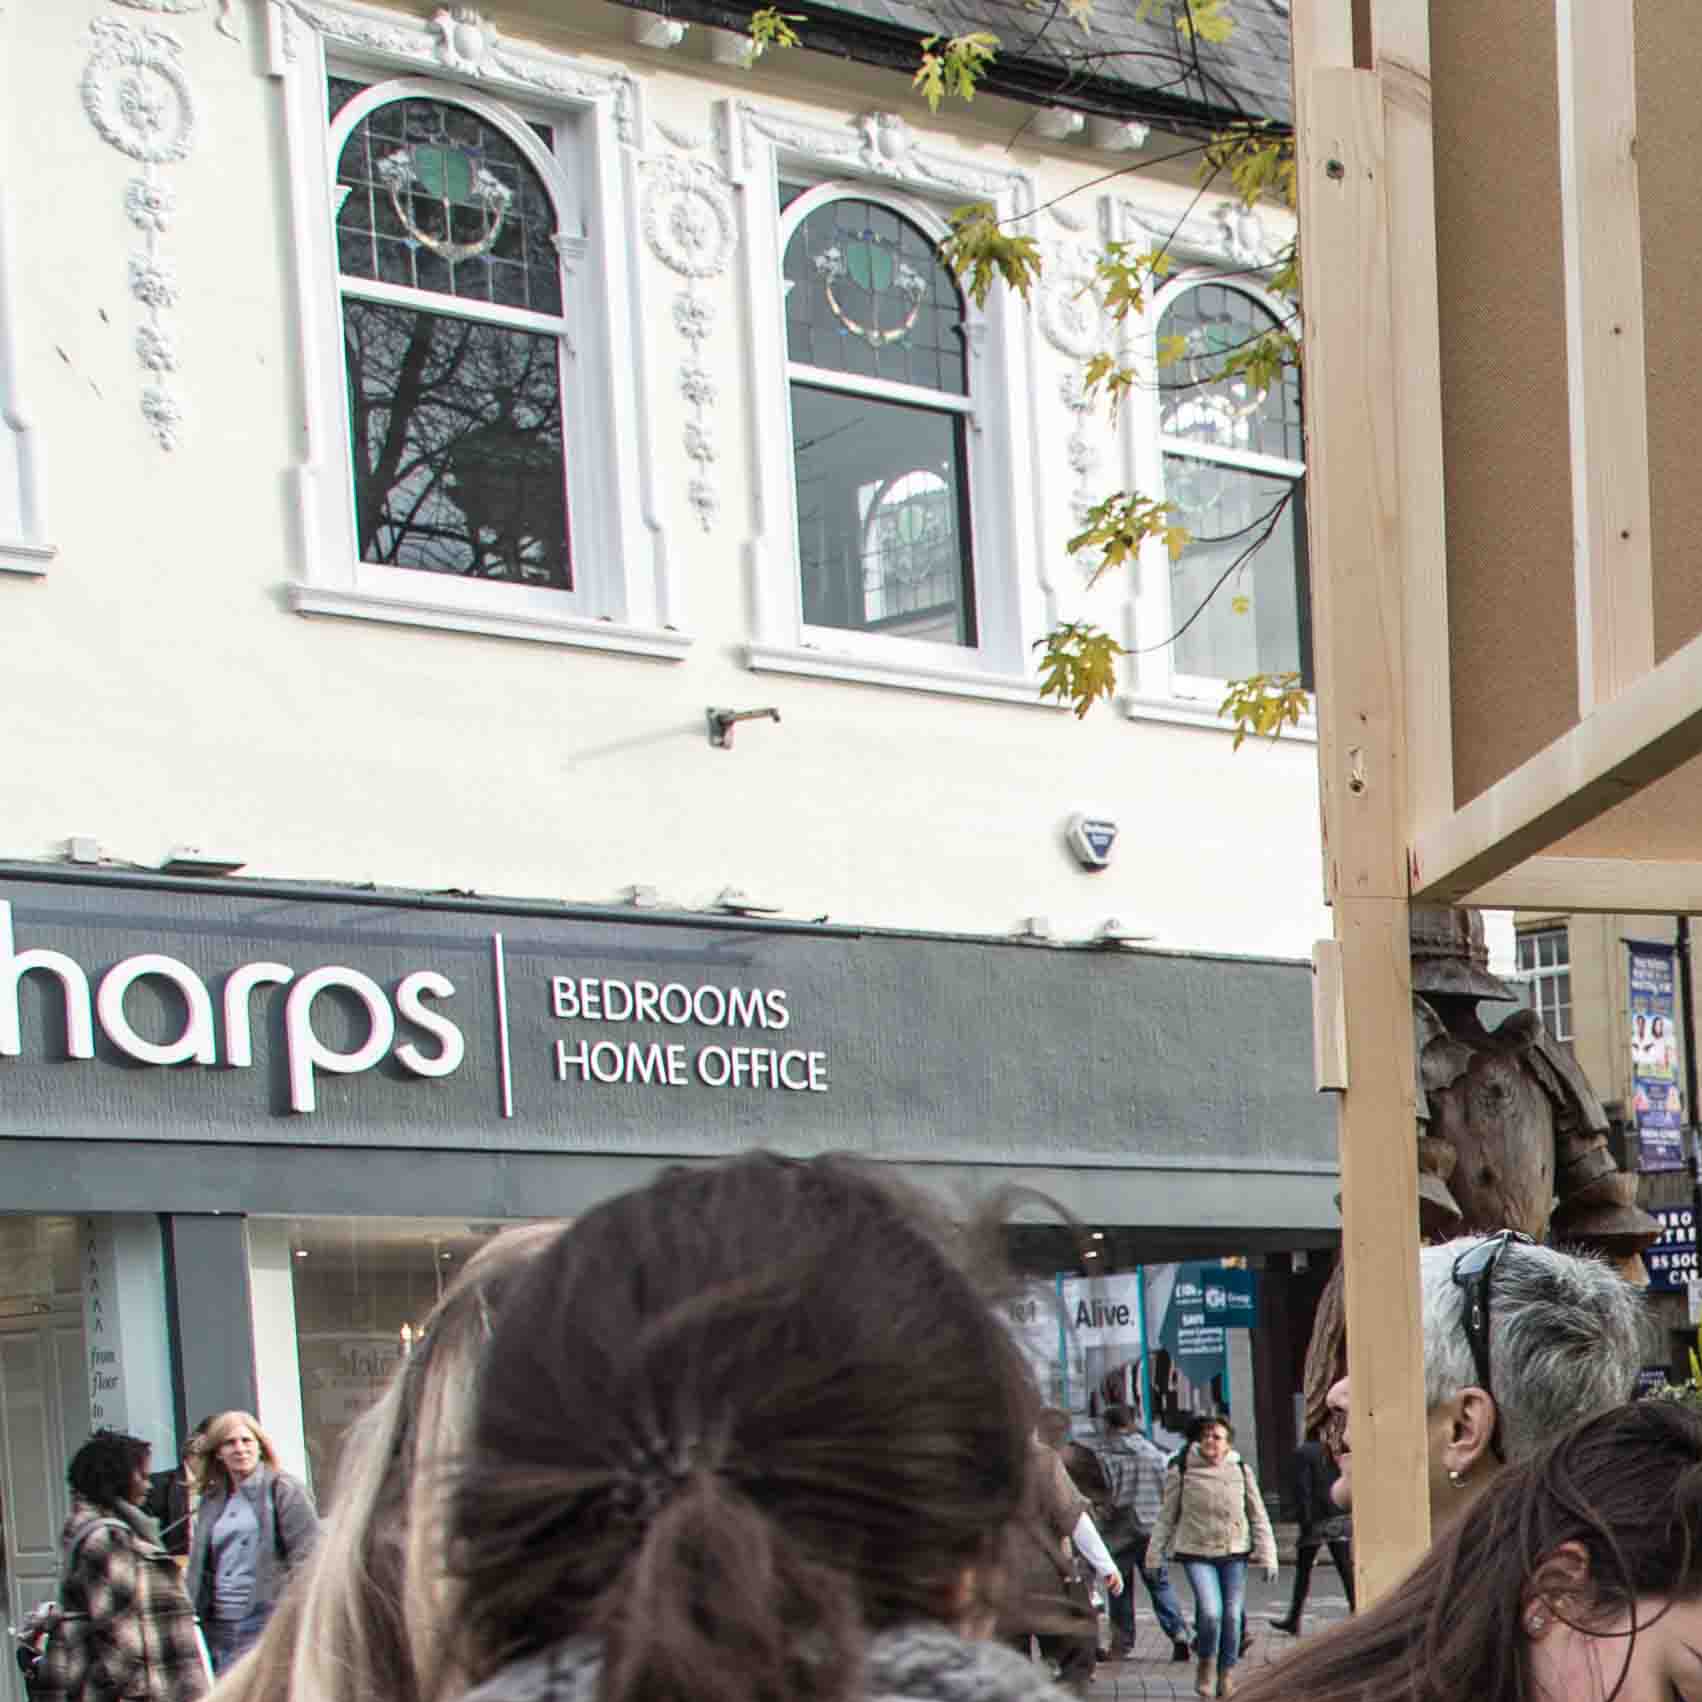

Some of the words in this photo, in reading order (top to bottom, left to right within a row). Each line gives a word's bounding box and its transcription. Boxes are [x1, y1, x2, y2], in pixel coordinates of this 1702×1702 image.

[551, 975, 791, 1031] BEDROOMS
[556, 1039, 688, 1086] HOME
[697, 1046, 829, 1093] OFFICE
[1668, 1268, 1700, 1286] CAR
